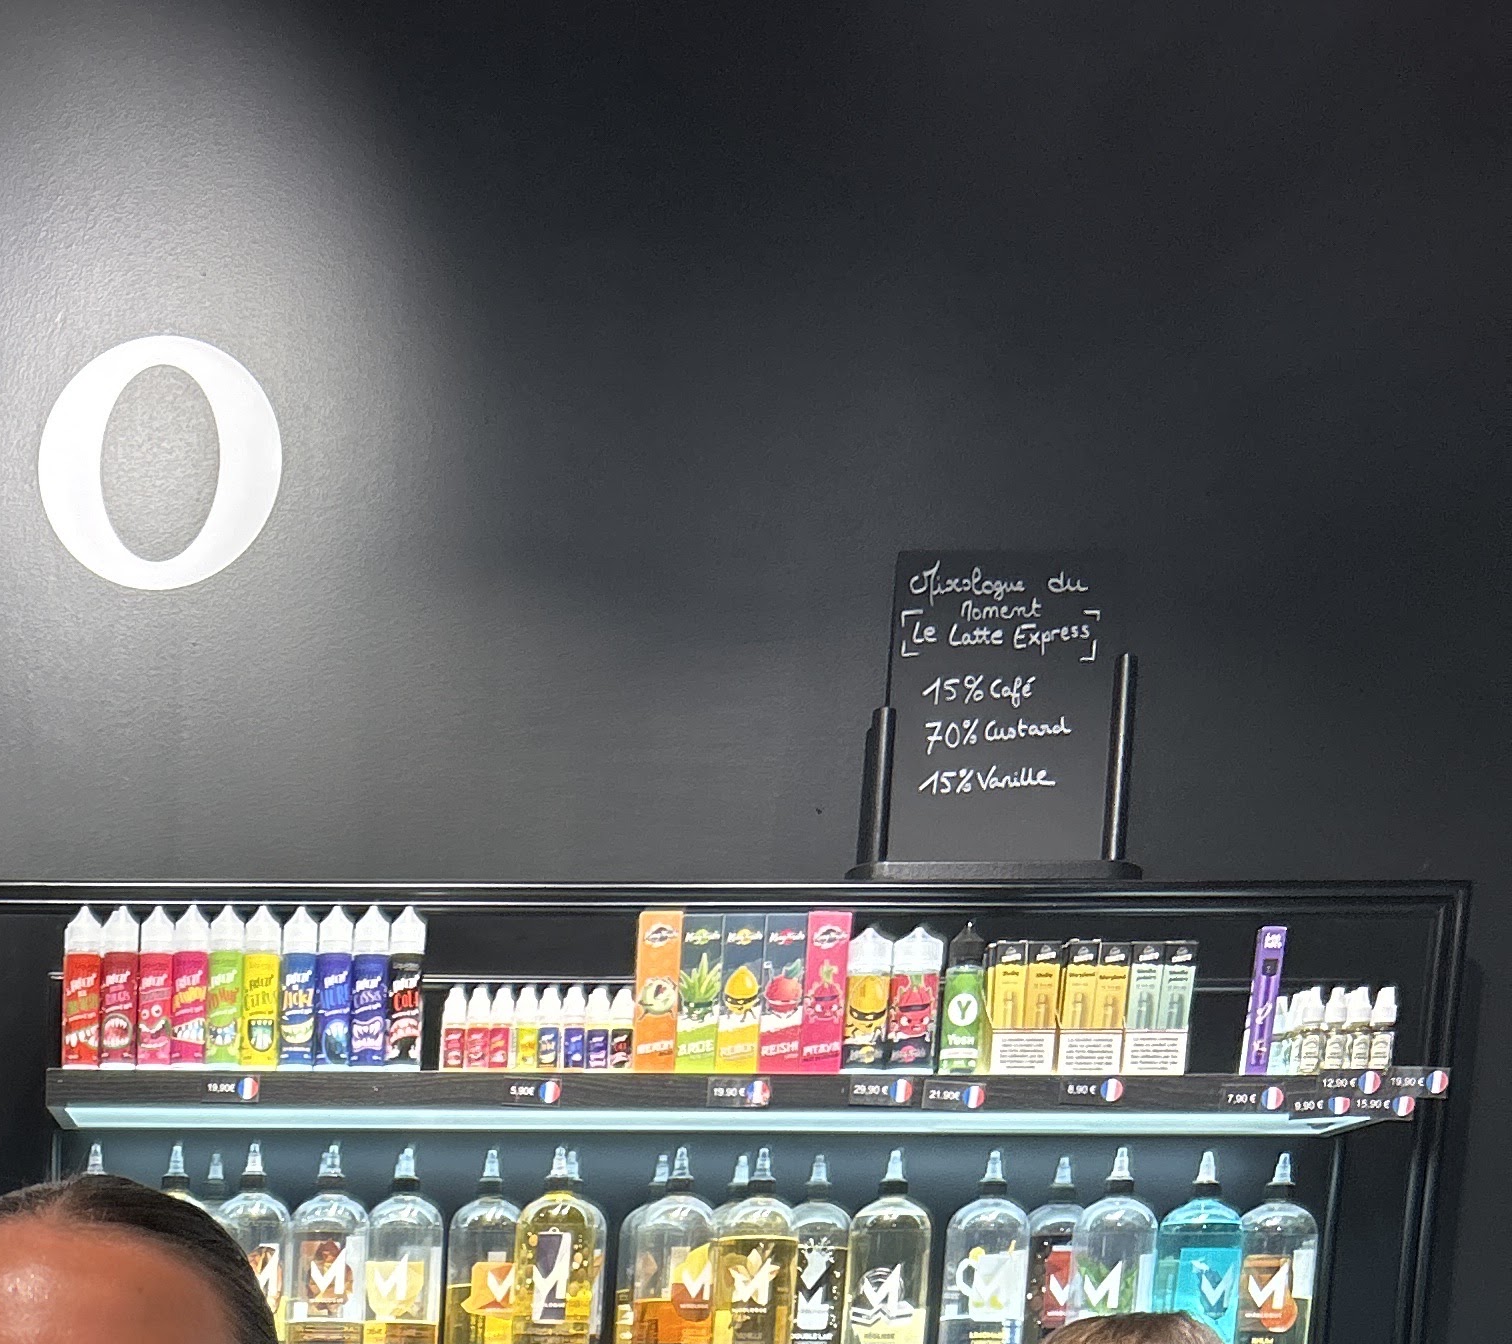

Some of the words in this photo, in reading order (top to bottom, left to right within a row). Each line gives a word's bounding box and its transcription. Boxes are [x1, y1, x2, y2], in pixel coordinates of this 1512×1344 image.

[909, 560, 1025, 606] Mixologue
[1048, 572, 1089, 592] du
[961, 599, 1042, 622] Moment
[913, 622, 937, 644] Le
[949, 624, 1004, 647] Latte
[1014, 623, 1091, 656] Express
[922, 675, 984, 705] 15%
[990, 677, 1036, 708] Café
[925, 719, 979, 755] 70%
[985, 716, 1072, 743] Custard
[918, 769, 975, 796] 15%
[977, 766, 1056, 791] Vanille
